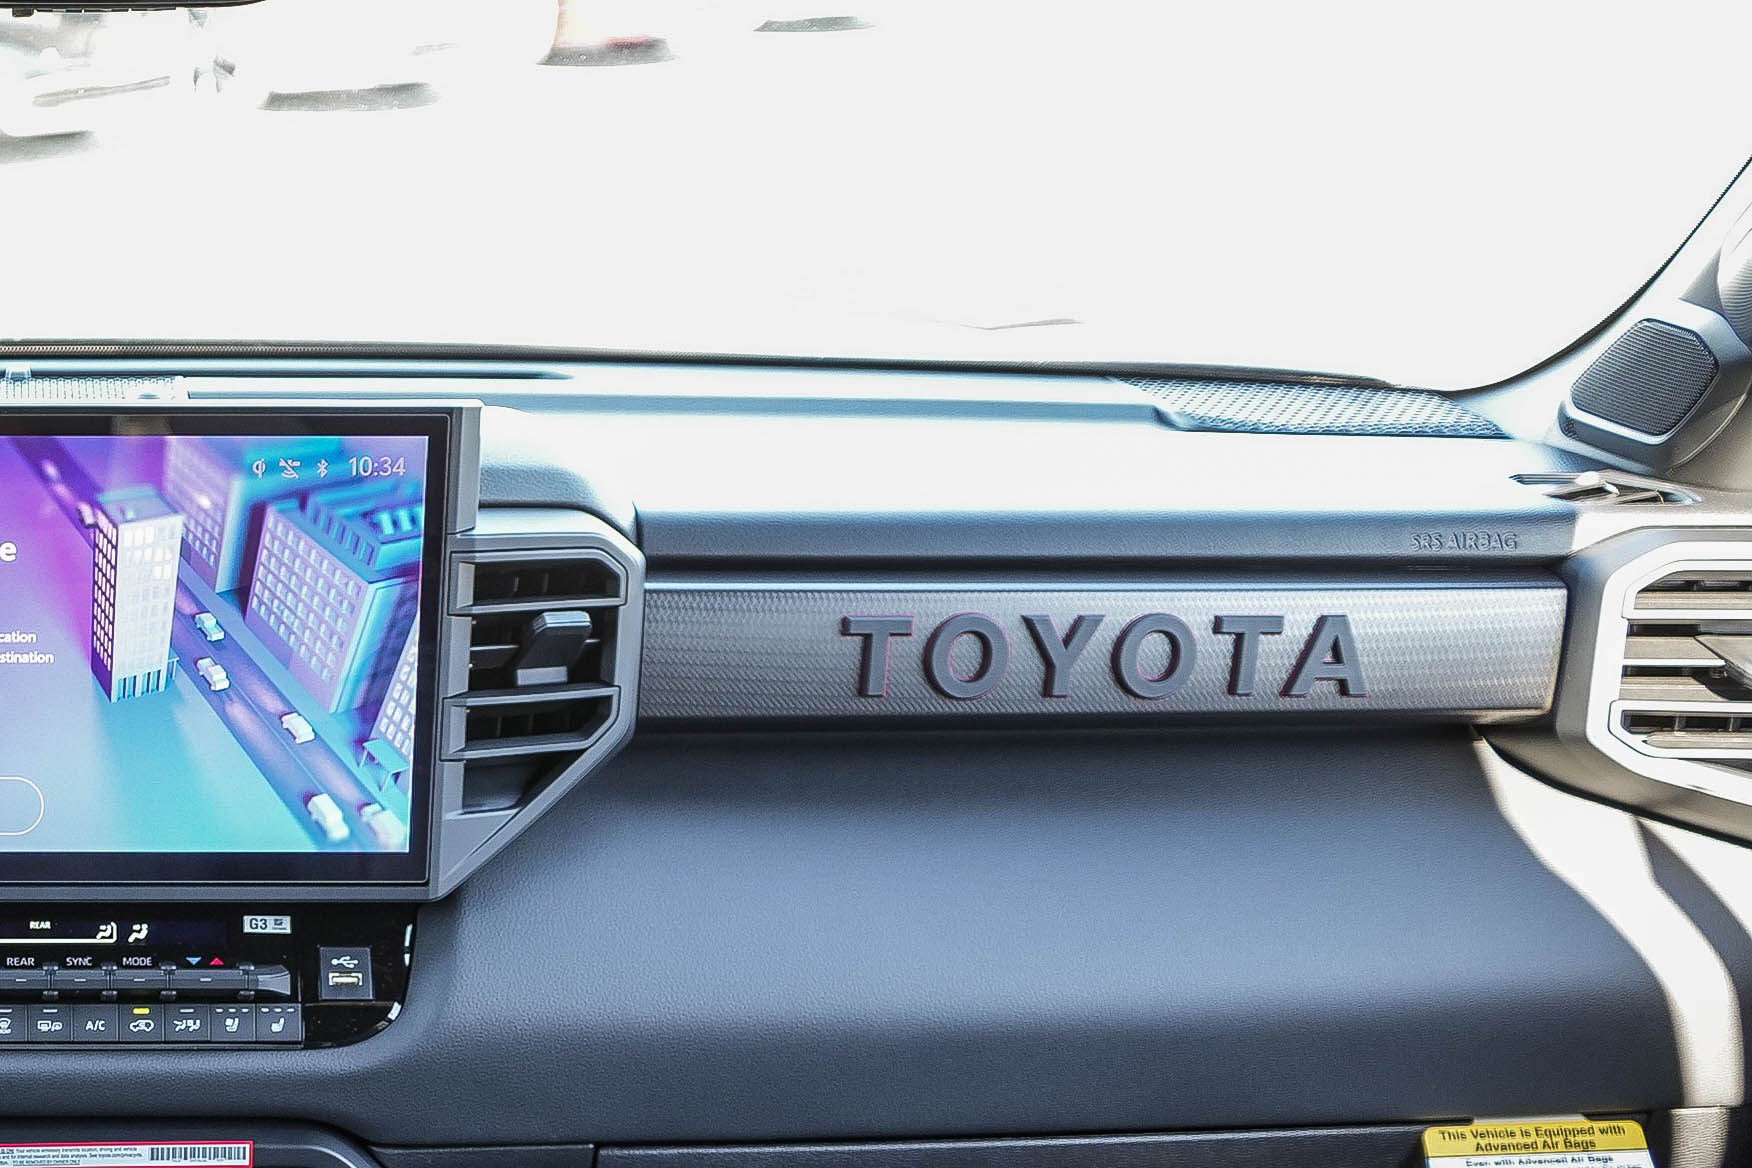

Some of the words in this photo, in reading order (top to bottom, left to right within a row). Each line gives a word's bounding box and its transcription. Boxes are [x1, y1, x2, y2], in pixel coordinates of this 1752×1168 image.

[348, 456, 406, 477] 10:34
[1411, 531, 1444, 551] SRS
[1447, 531, 1518, 551] AIRBAG
[842, 611, 1371, 700] TOYOTA
[249, 918, 268, 930] G3
[6, 957, 35, 966] REAR
[66, 957, 93, 966] SYNC
[122, 957, 152, 966] MODE
[86, 1020, 106, 1031] A/C
[1439, 1130, 1467, 1141] This
[1470, 1128, 1516, 1139] Vehicle
[1521, 1127, 1531, 1138] is
[1535, 1126, 1595, 1141] Equipped
[1599, 1125, 1626, 1135] with
[1475, 1141, 1539, 1152] Advanced
[1542, 1140, 1560, 1150] Air
[1564, 1139, 1596, 1151] Bags
